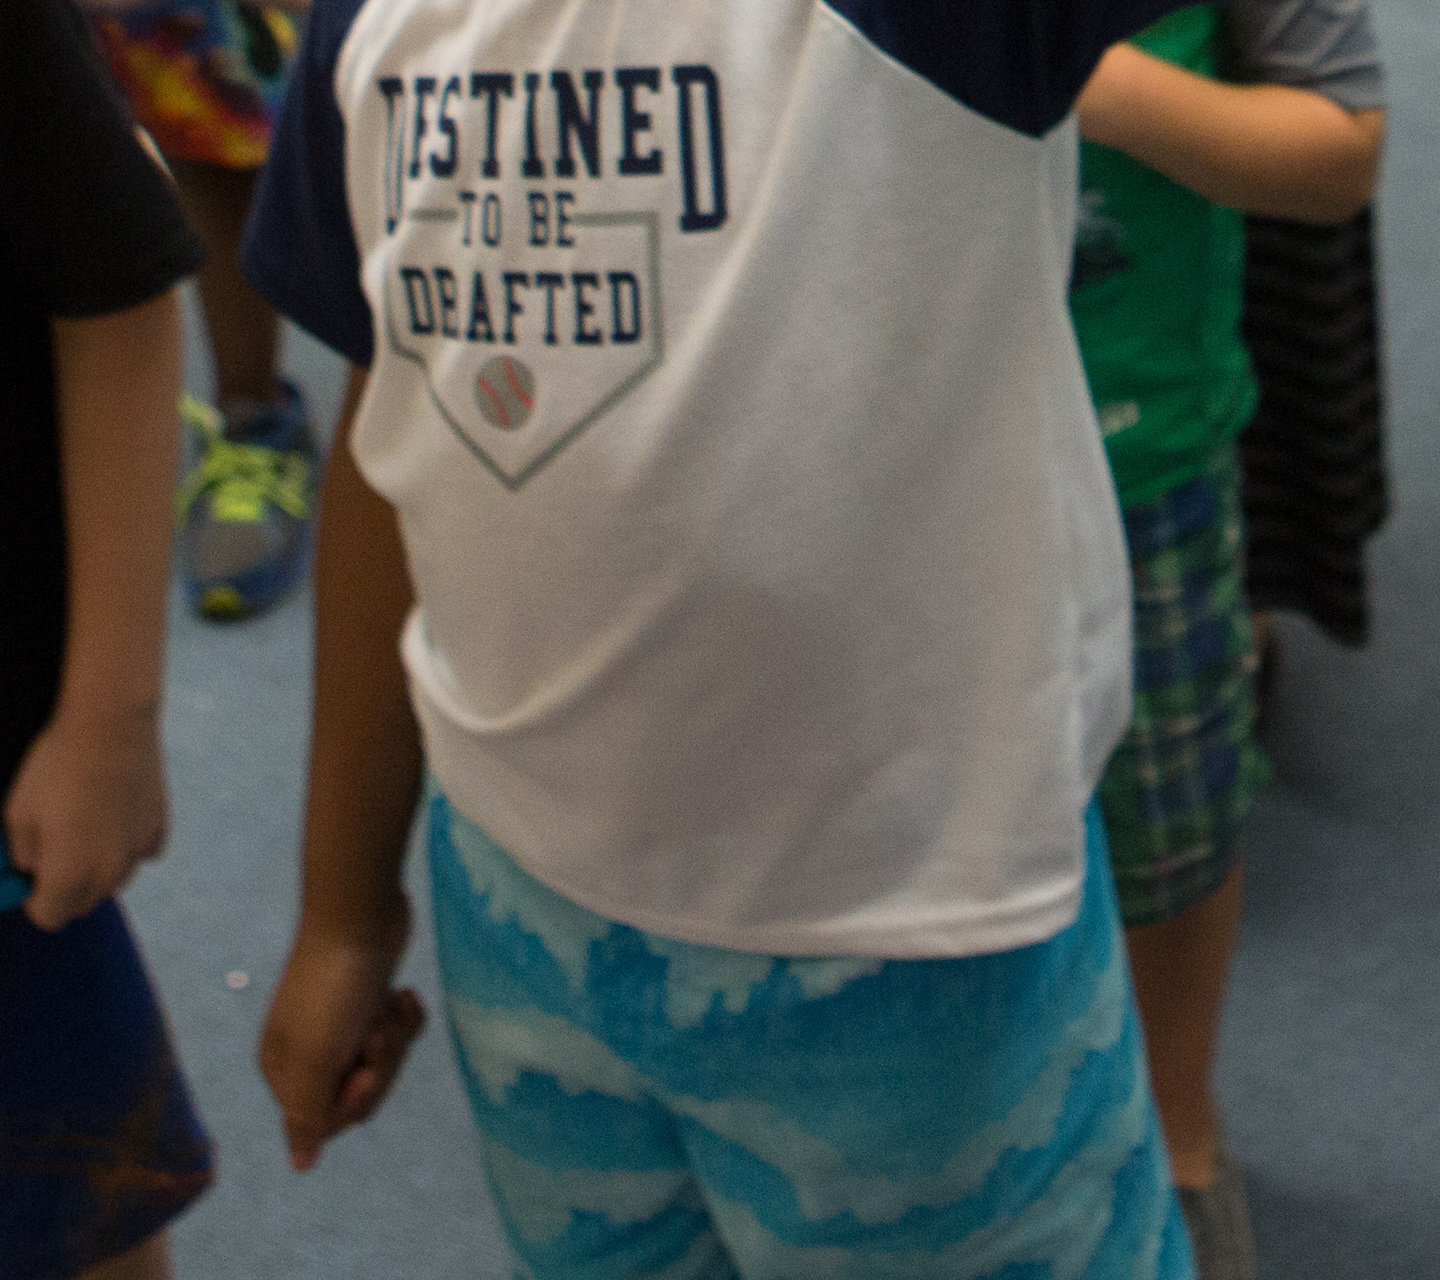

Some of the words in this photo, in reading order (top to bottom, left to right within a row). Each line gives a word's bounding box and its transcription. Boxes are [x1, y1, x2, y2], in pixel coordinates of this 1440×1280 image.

[459, 191, 502, 247] TO
[527, 191, 576, 247] BE
[400, 266, 642, 345] DRAFTED
